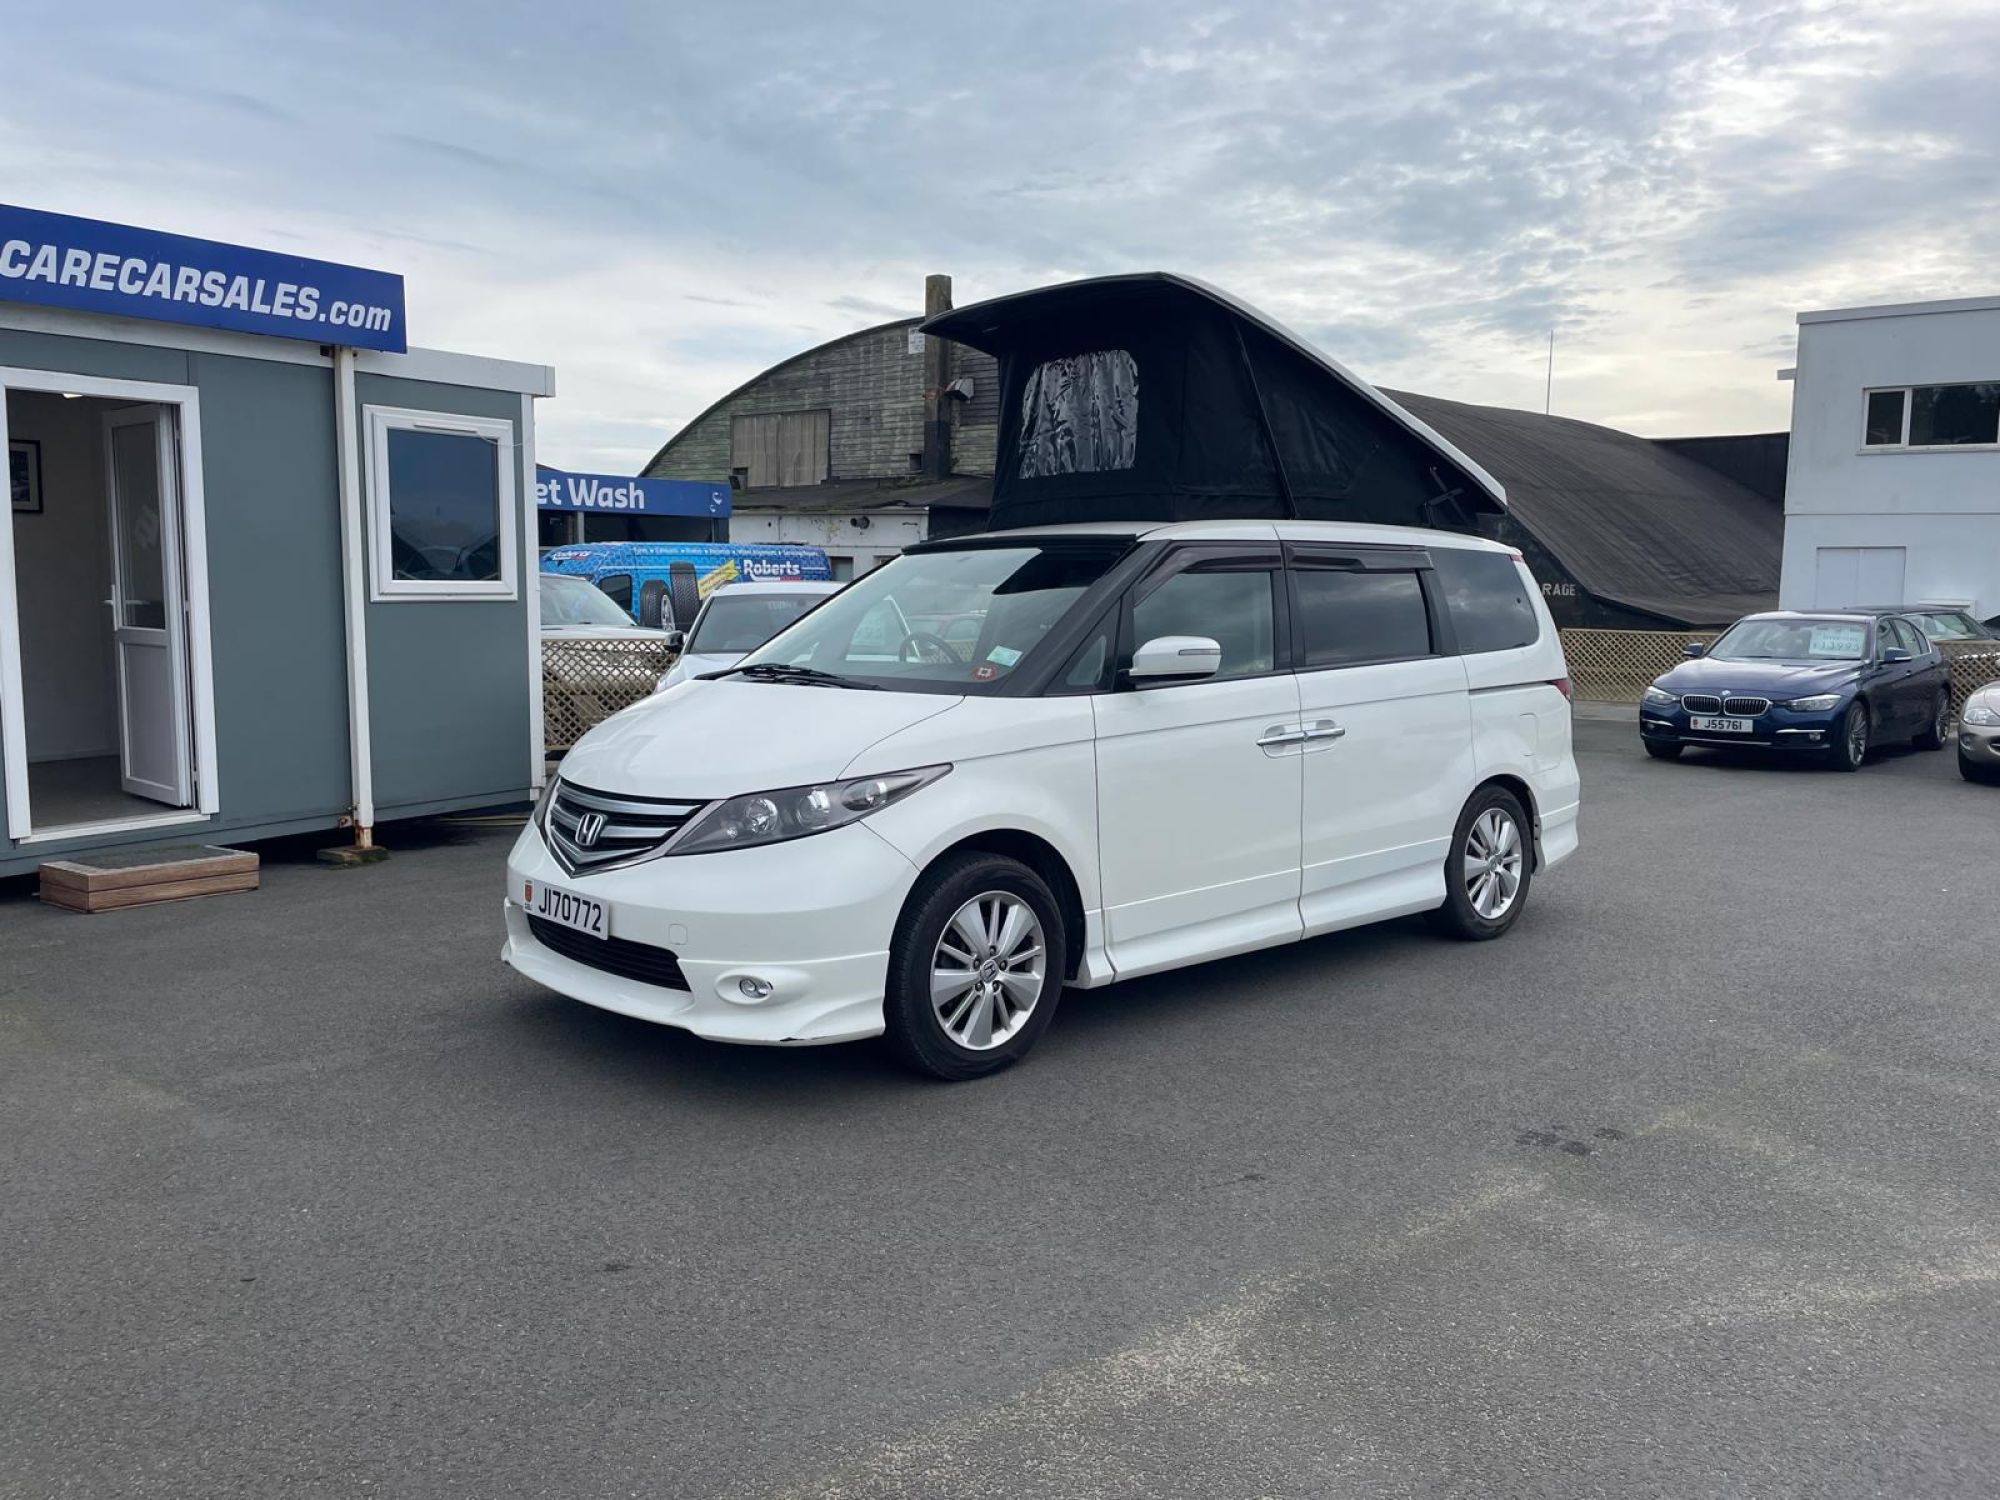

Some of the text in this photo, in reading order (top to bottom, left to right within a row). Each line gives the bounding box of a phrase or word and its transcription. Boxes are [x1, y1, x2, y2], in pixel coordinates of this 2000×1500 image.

[0, 239, 392, 332] CARECARSALES.com
[567, 478, 645, 510] Wash
[743, 559, 801, 578] Roberts
[1703, 719, 1743, 731] J55761
[538, 886, 602, 932] J170772
